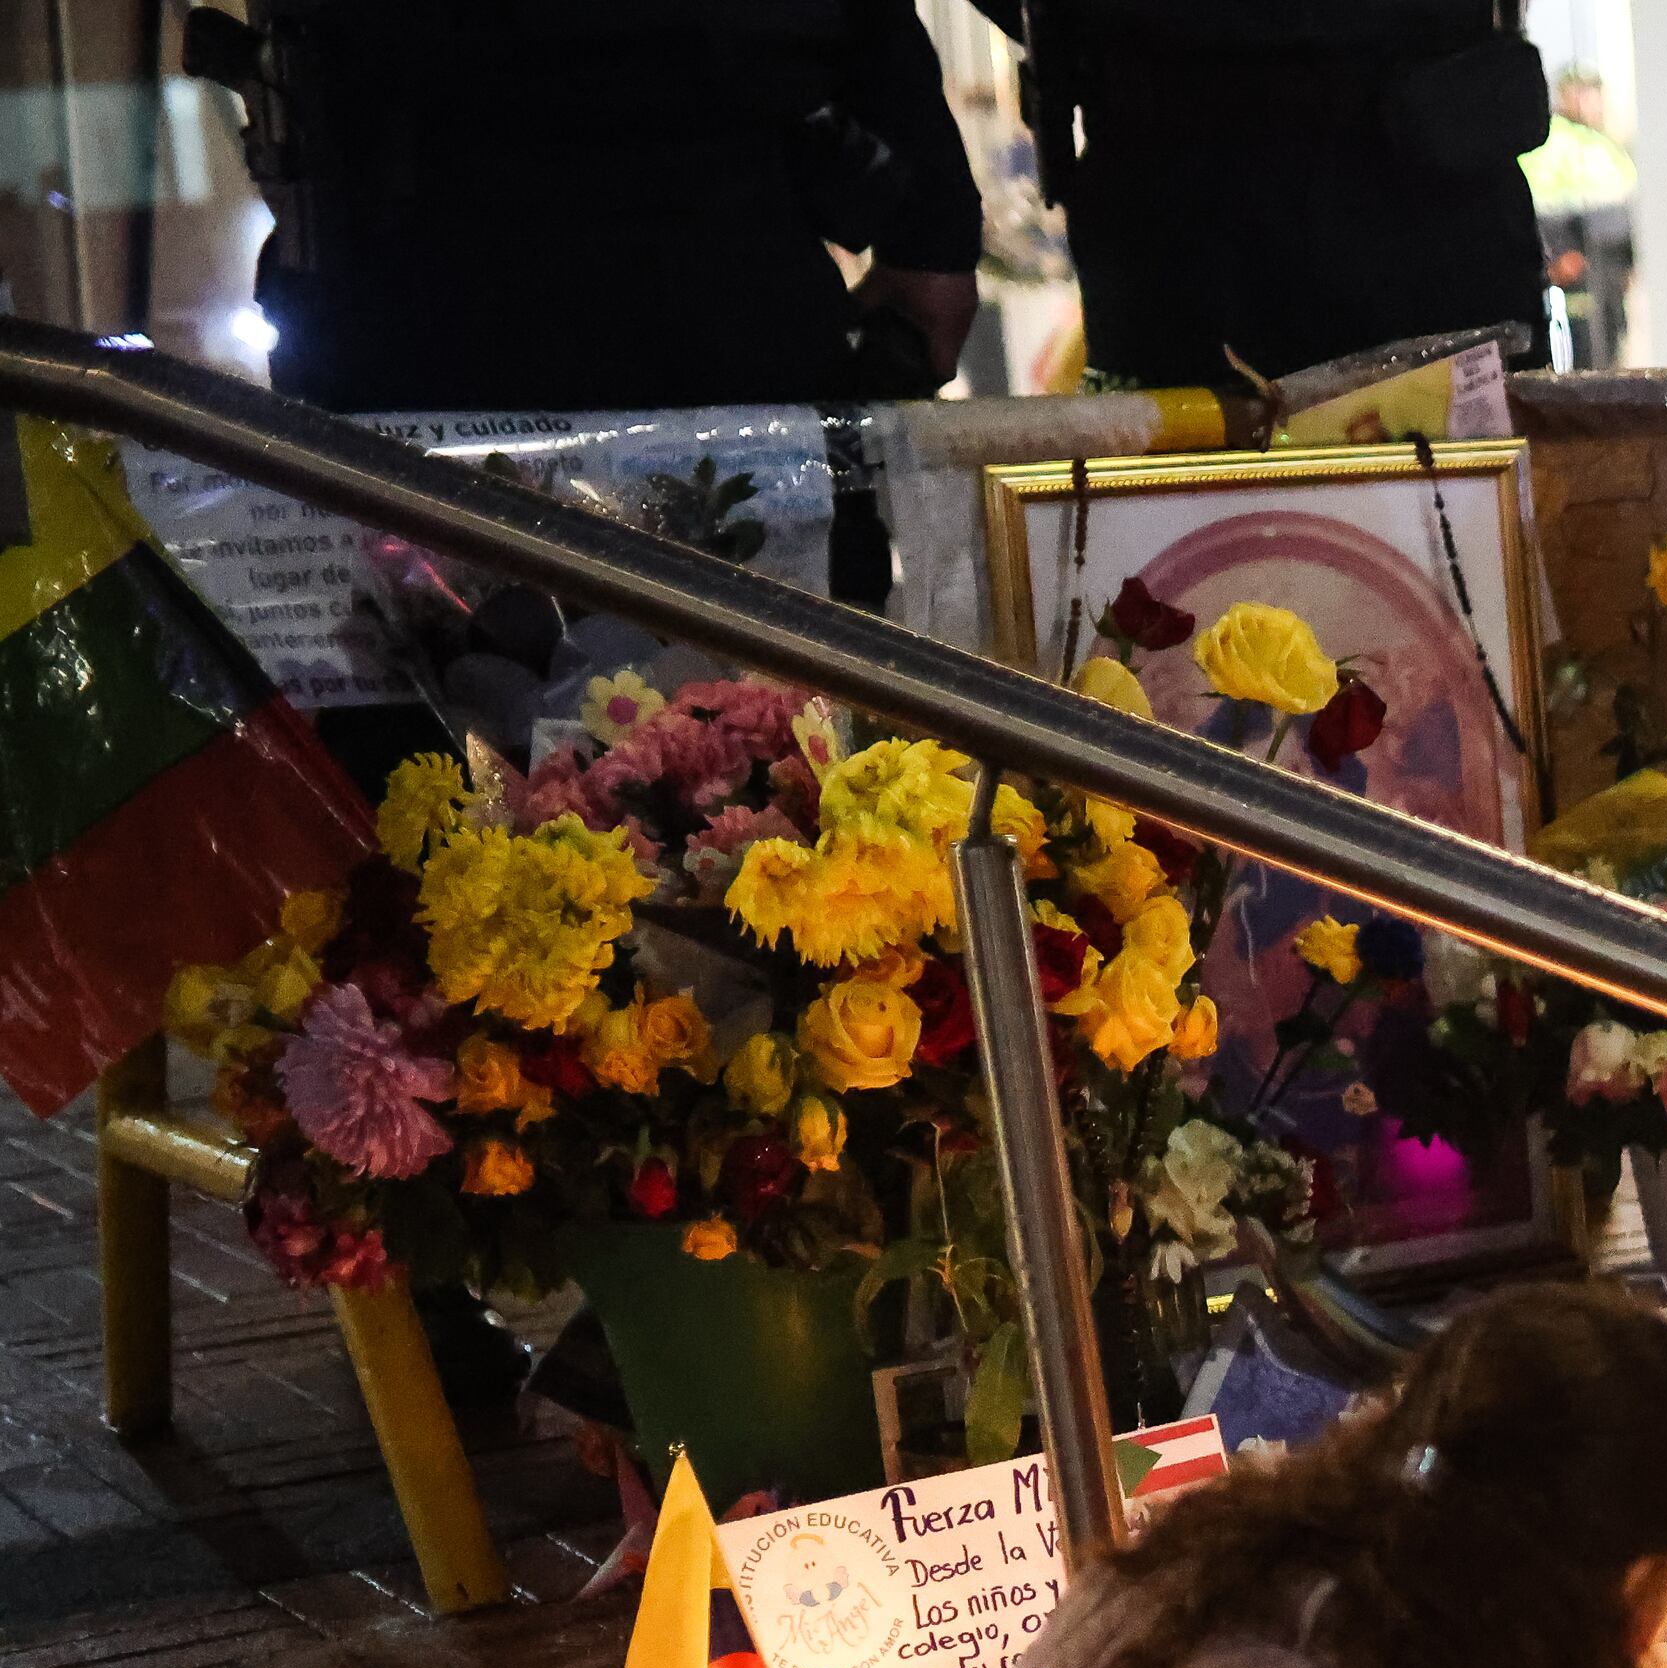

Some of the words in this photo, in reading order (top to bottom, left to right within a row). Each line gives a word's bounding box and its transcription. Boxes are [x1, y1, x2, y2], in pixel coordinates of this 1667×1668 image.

[455, 417, 572, 437] cuidado
[880, 1486, 996, 1544] Fuerza
[807, 1512, 901, 1578] EDUCATIVA
[904, 1544, 984, 1588] Desde
[998, 1530, 1028, 1565] la
[911, 1593, 960, 1630] Los
[967, 1582, 1037, 1617] niños
[879, 1617, 905, 1658] AMOR
[898, 1622, 1010, 1660] colegio,
